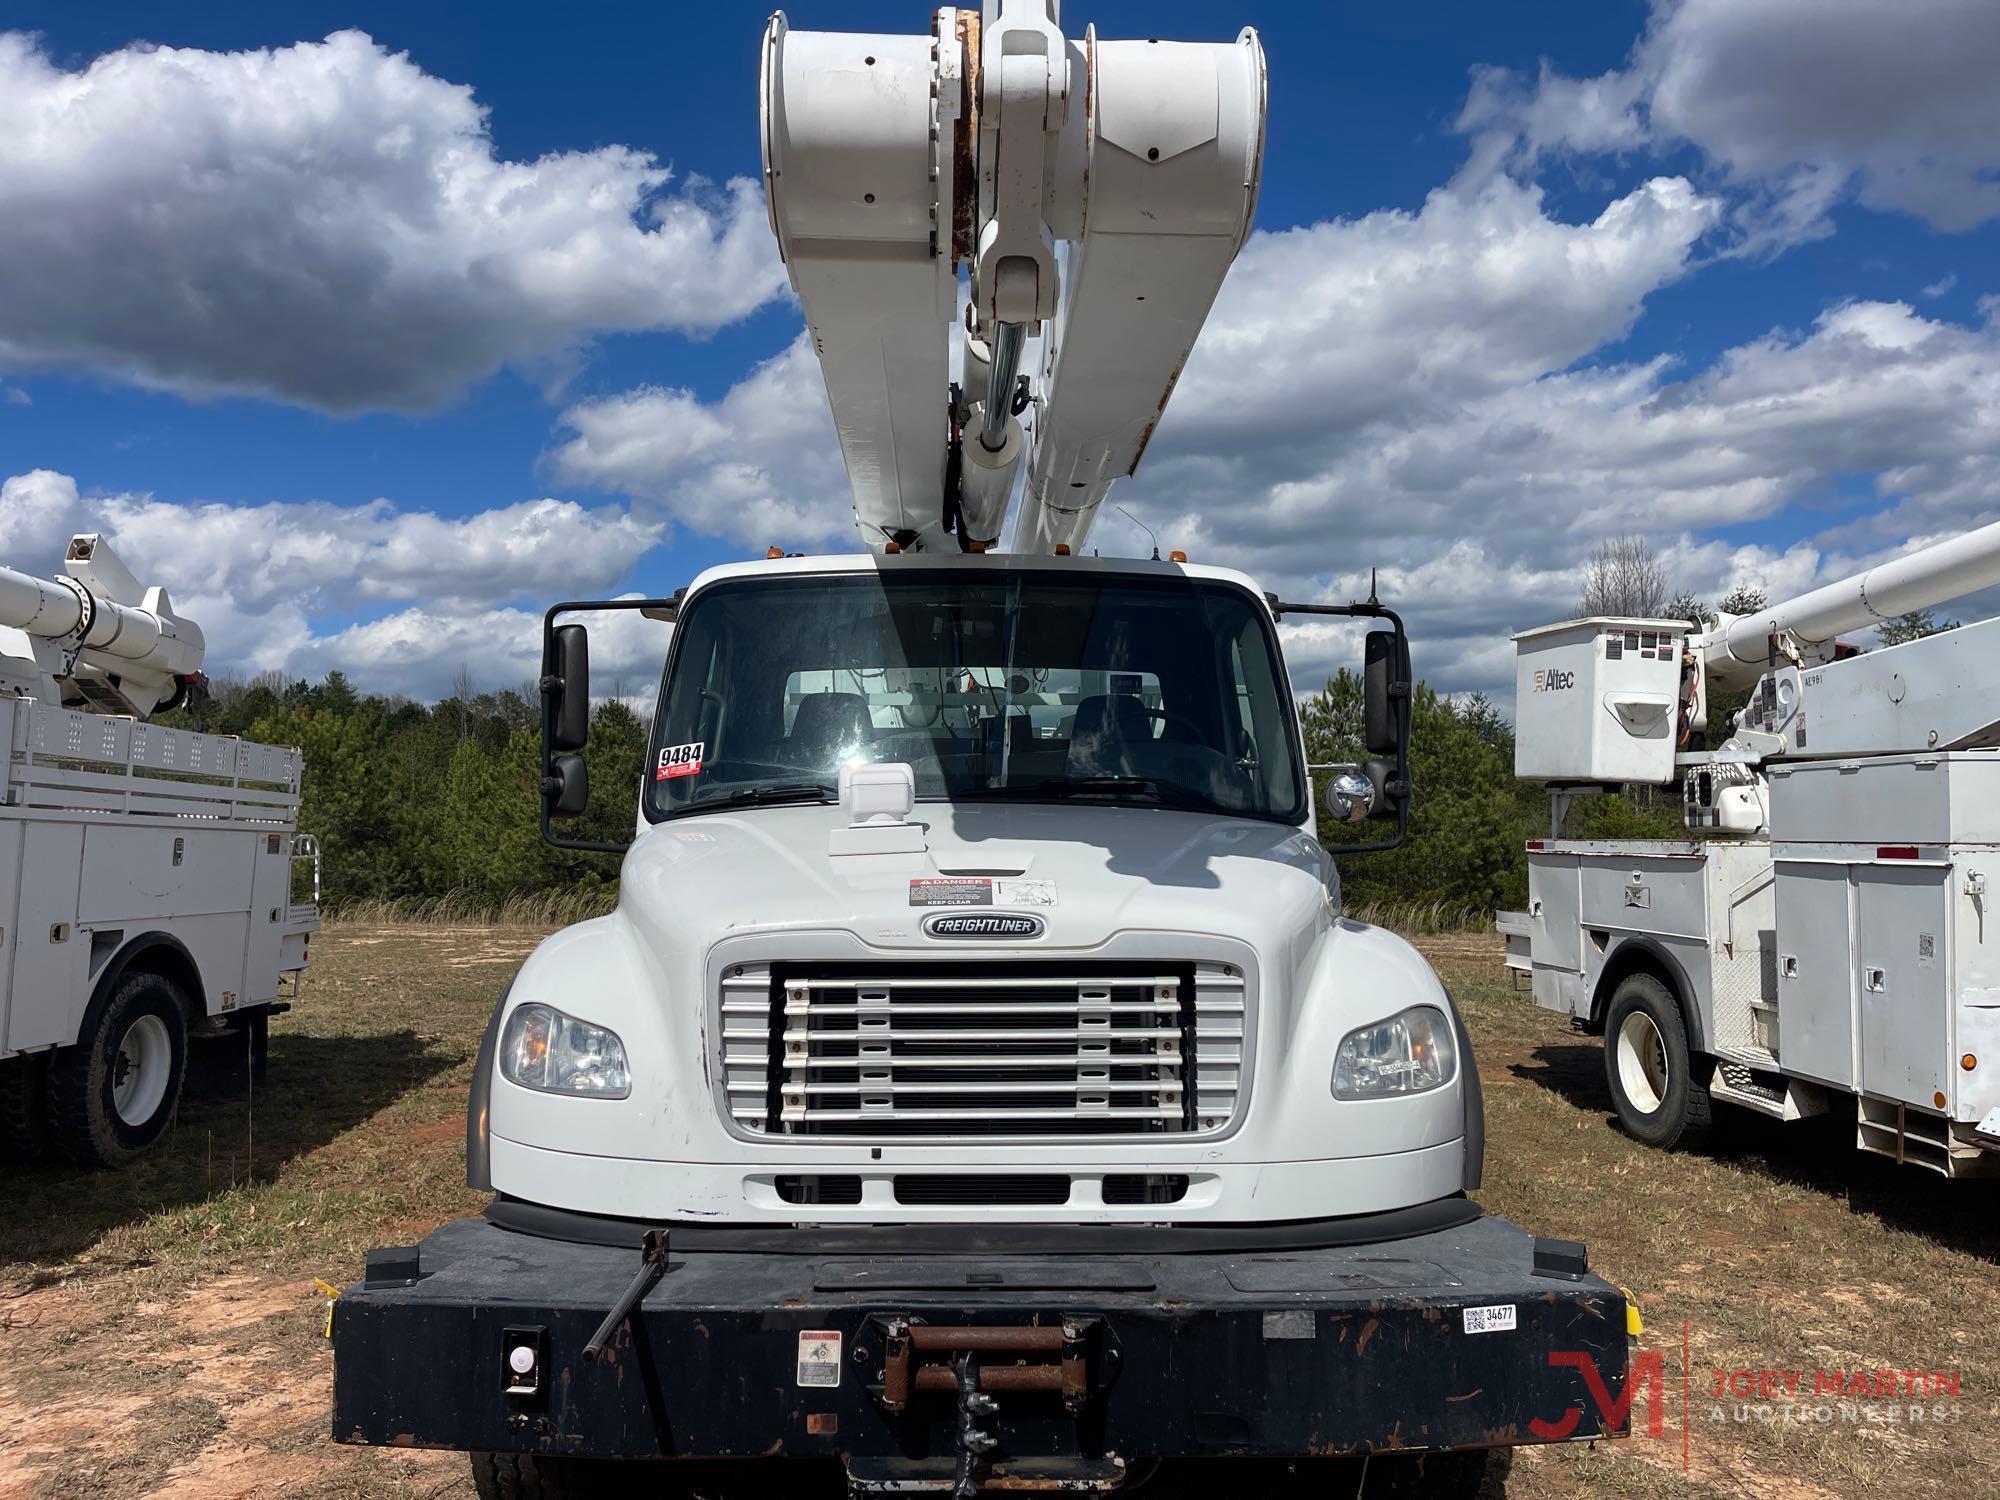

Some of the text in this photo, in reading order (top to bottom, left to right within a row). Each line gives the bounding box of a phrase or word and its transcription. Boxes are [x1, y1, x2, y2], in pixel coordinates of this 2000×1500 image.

[1545, 668, 1574, 691] Altec
[660, 744, 702, 767] 9484
[936, 919, 1031, 932] FREIGHTLINER
[1486, 1307, 1513, 1321] 34677
